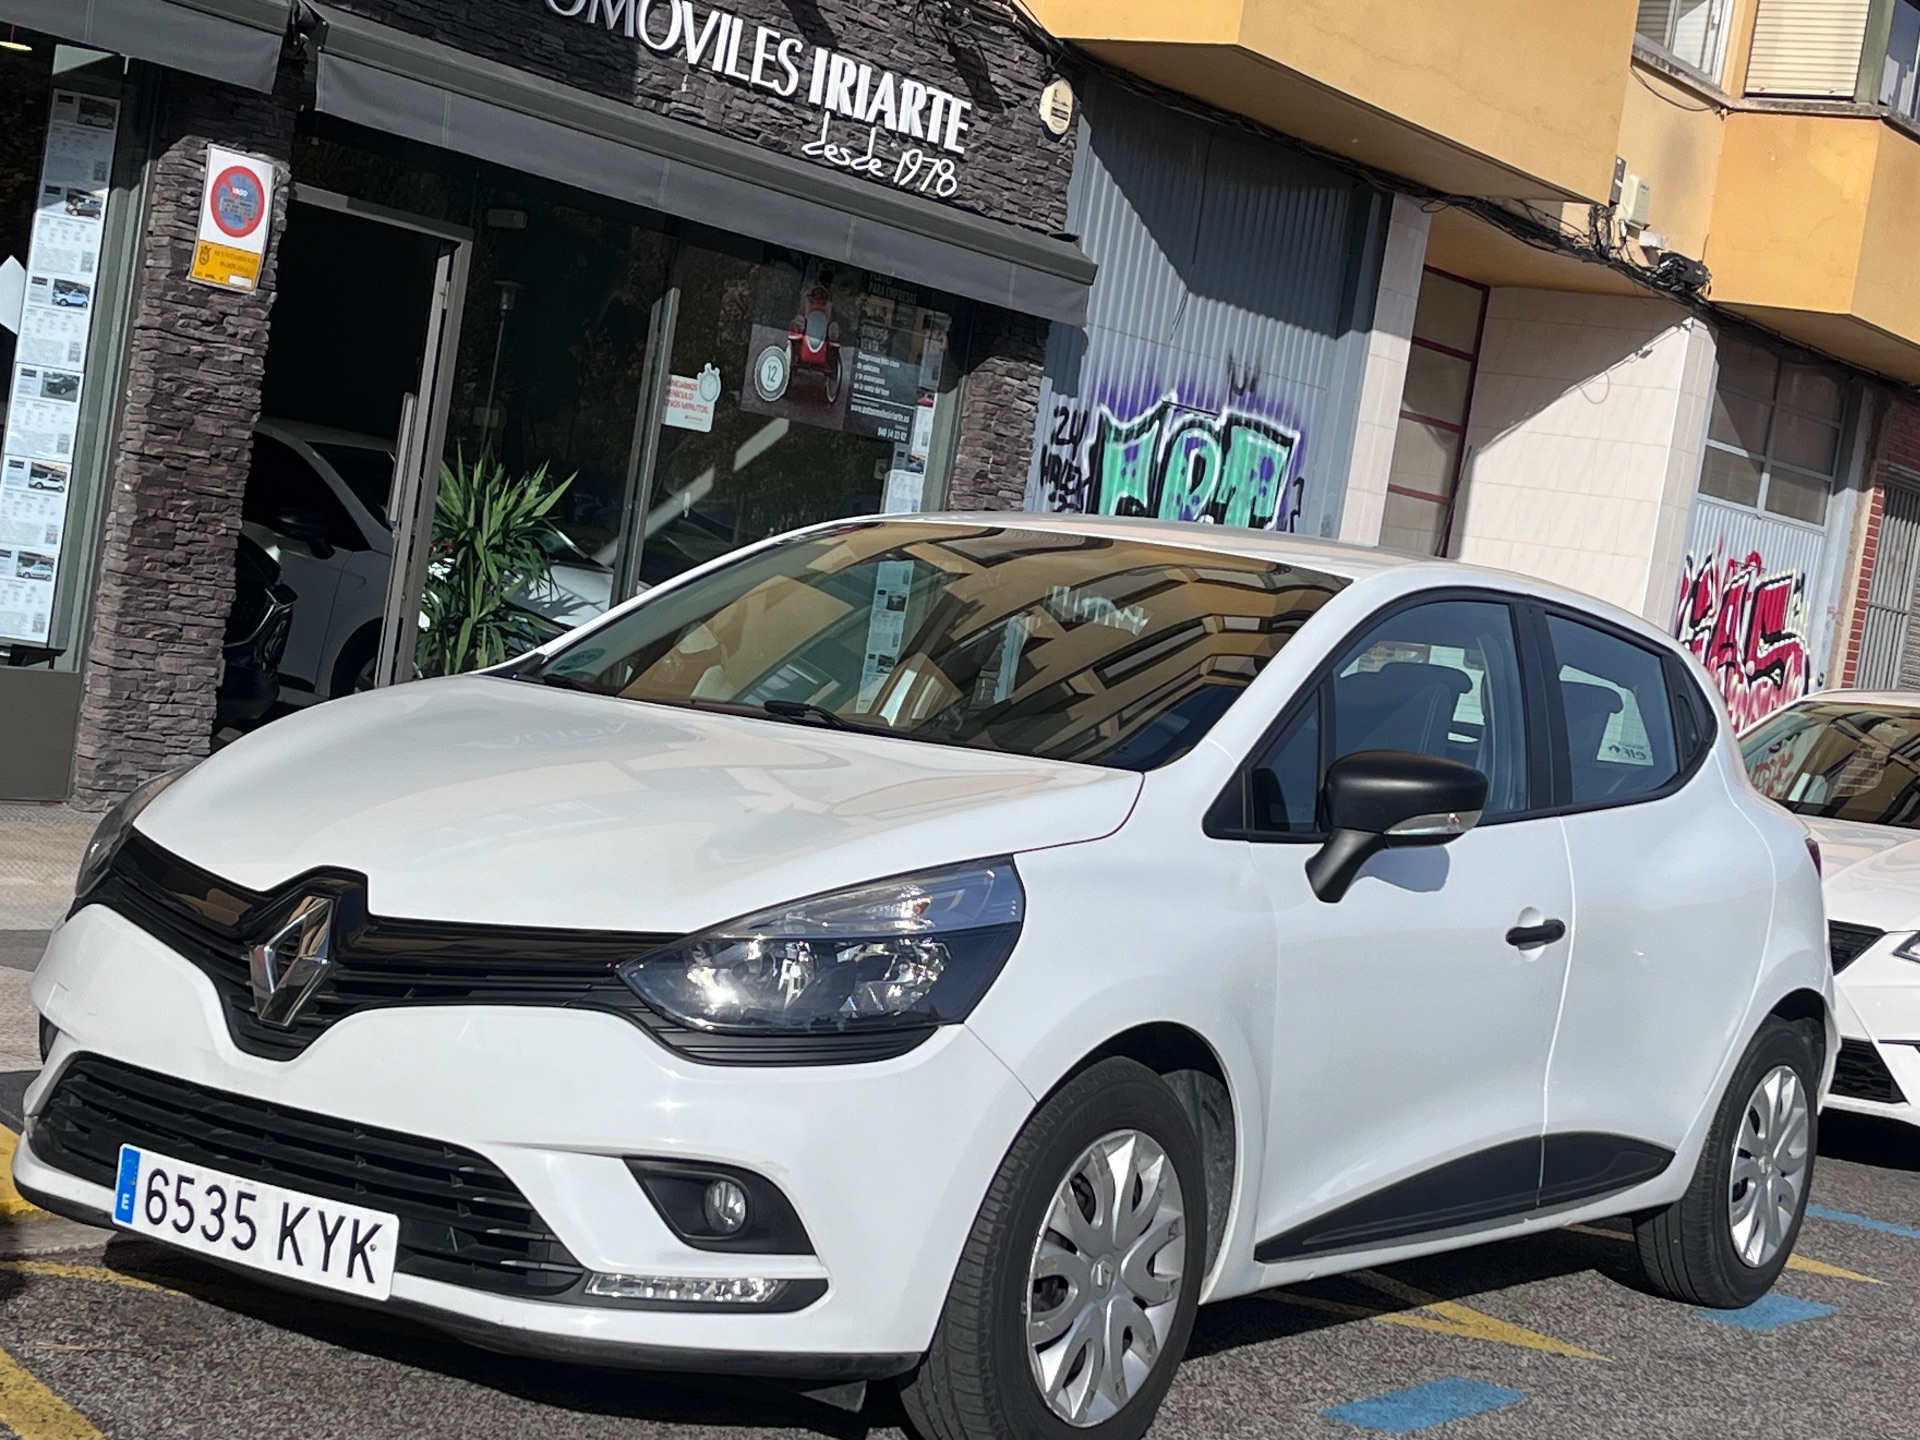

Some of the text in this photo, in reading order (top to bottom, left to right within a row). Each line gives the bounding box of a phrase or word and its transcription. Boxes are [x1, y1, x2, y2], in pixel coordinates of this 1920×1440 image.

[545, 0, 972, 154] MOVILES IRIARTE
[801, 111, 957, 197] desde 1978
[767, 364, 778, 383] 12
[120, 1192, 130, 1210] E
[145, 1168, 383, 1284] 6535 KYK
